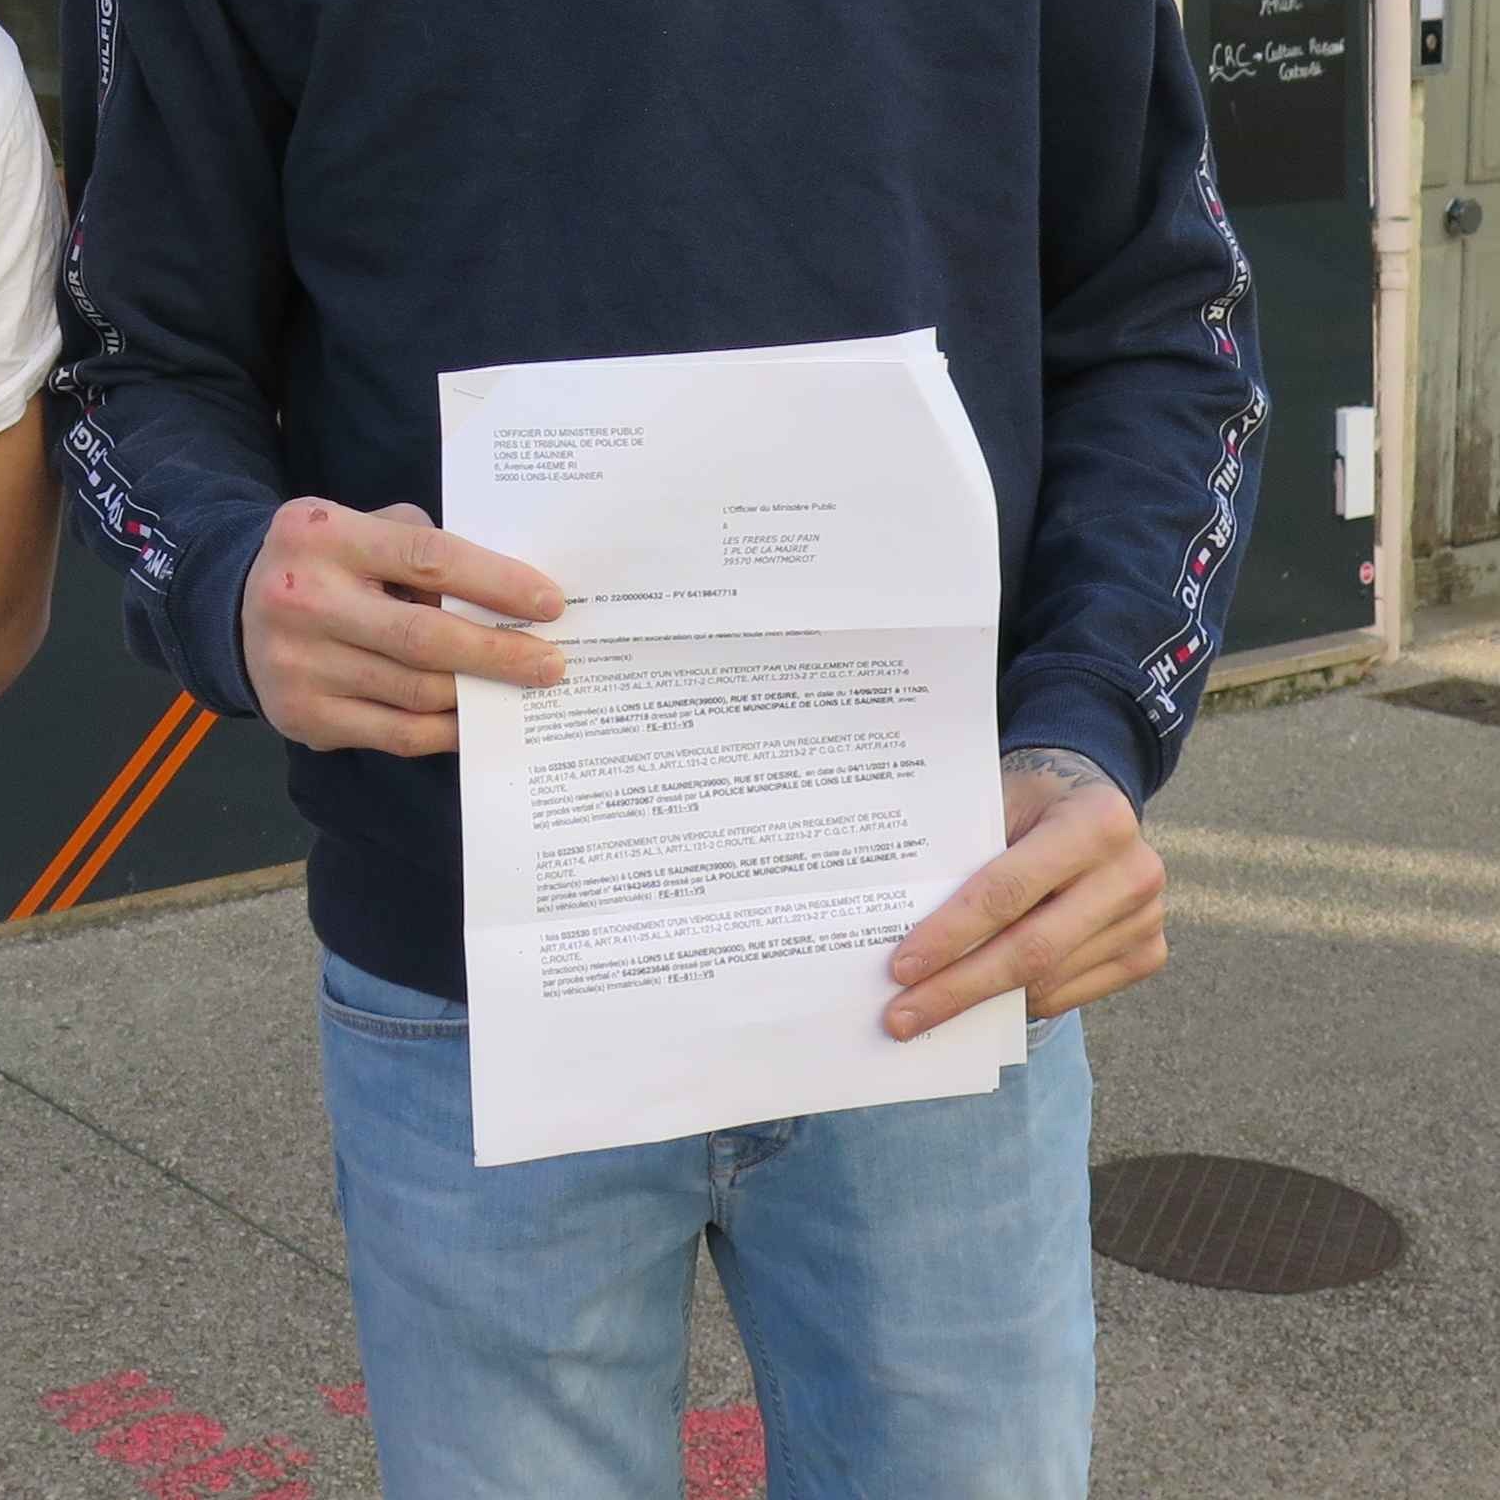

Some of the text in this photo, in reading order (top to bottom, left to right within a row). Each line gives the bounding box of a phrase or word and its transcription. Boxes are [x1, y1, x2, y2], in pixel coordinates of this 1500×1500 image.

[610, 427, 644, 436] PUBLIC
[595, 438, 629, 447] POLICE
[494, 450, 574, 460] LONS LE SAUNIER
